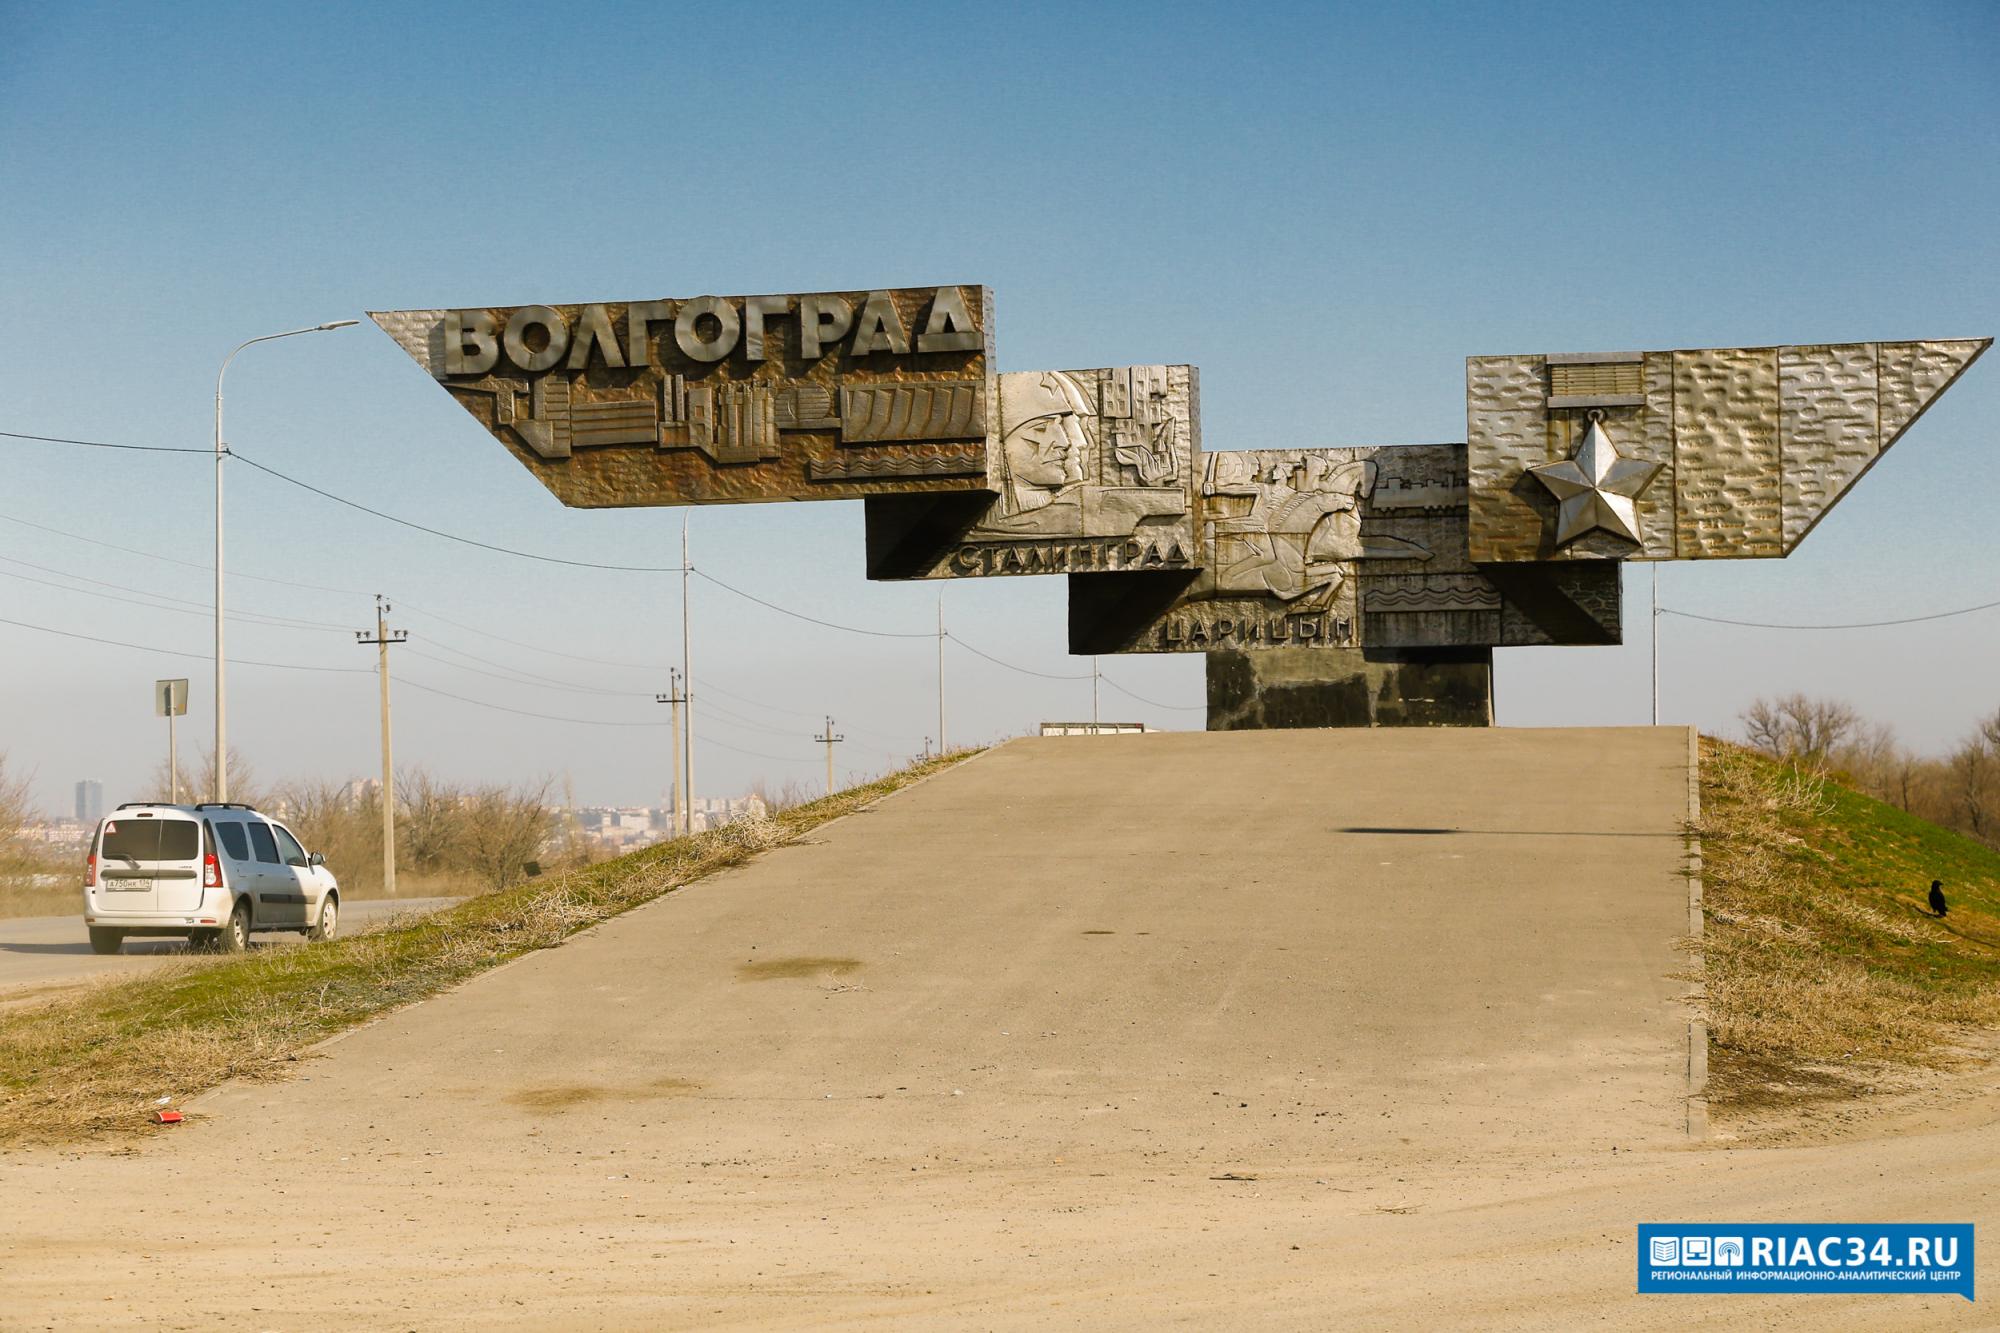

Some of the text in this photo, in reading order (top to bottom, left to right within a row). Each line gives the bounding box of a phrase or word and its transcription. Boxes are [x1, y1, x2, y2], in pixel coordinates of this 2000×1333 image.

[444, 287, 985, 376] ВОЛГОГРАД
[958, 537, 1190, 569] СТАЛИНГРАД
[1166, 616, 1354, 642] ЦАРИЦЫН
